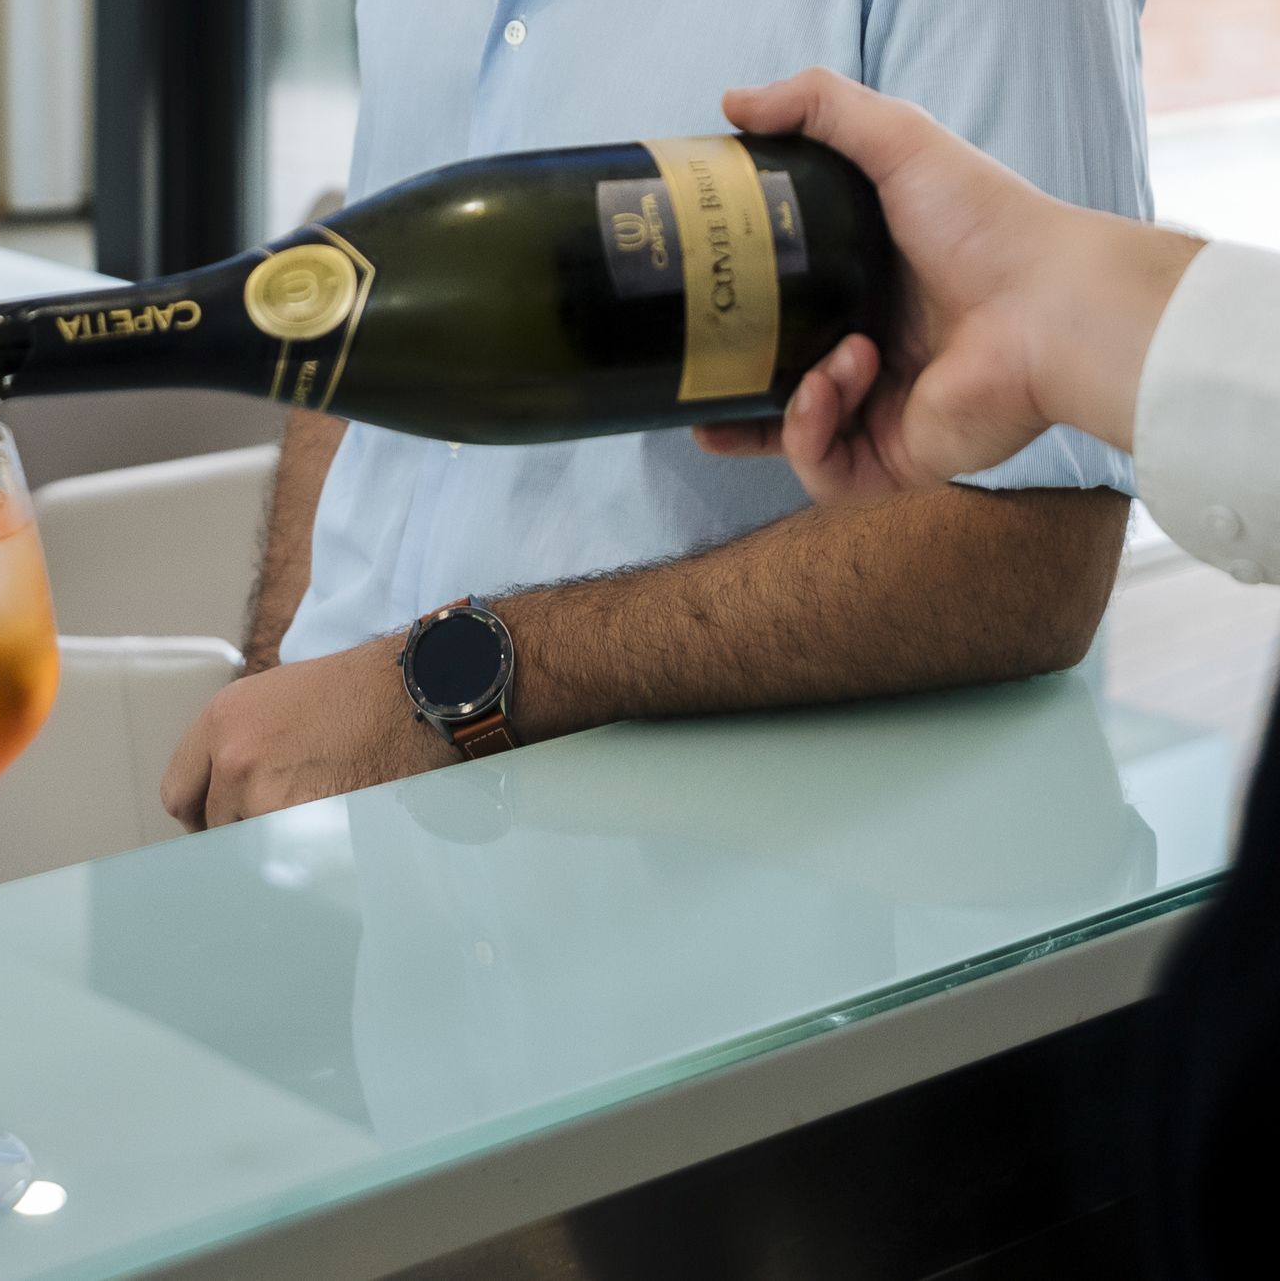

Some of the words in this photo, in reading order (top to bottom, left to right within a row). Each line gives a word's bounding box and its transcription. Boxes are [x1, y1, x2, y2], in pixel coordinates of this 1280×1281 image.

[689, 158, 723, 212] BRUT
[640, 193, 668, 269] CAPETTA
[56, 300, 202, 342] CAPETTA
